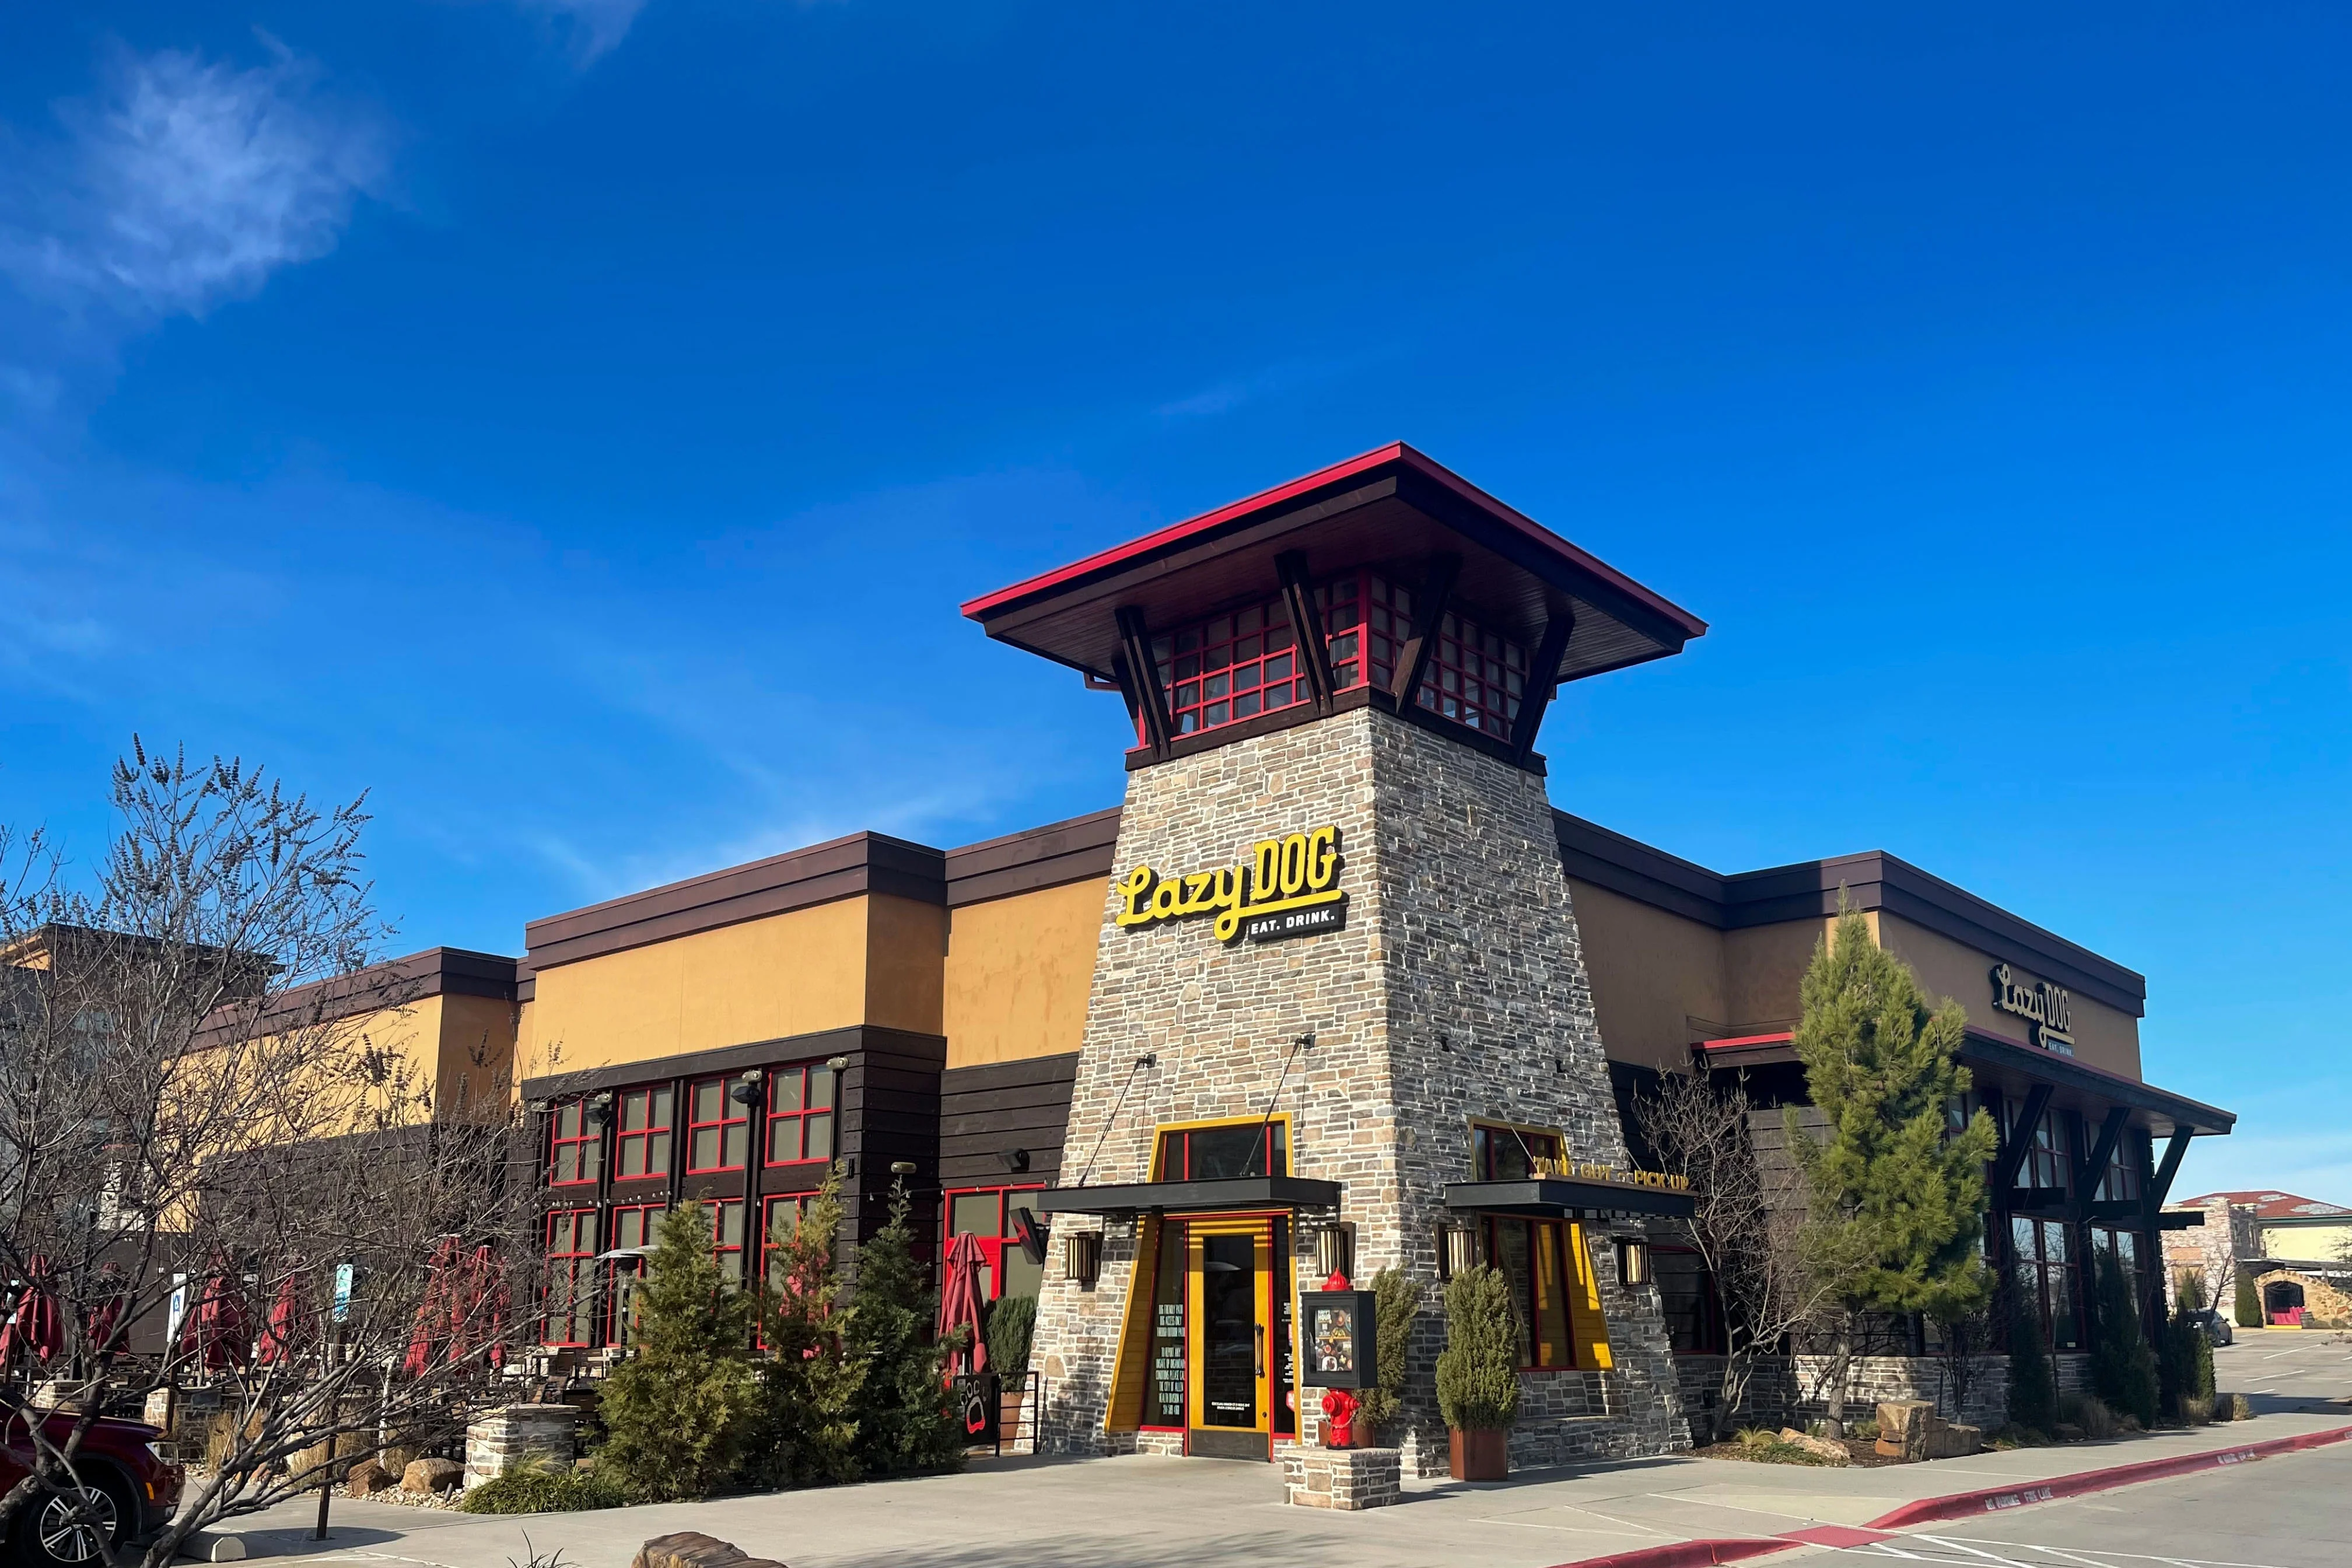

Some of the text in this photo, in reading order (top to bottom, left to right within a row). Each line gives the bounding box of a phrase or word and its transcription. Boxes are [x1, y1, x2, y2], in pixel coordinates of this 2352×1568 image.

[1115, 825, 1338, 940] Lazy DOG
[1251, 909, 1335, 935] EAT. DRINK.
[1994, 963, 2071, 1048] Lazy DOG
[1533, 1156, 1575, 1175] TAKE
[1580, 1160, 1614, 1181] OUT
[1634, 1169, 1666, 1188] PICK
[1670, 1174, 1689, 1190] UP
